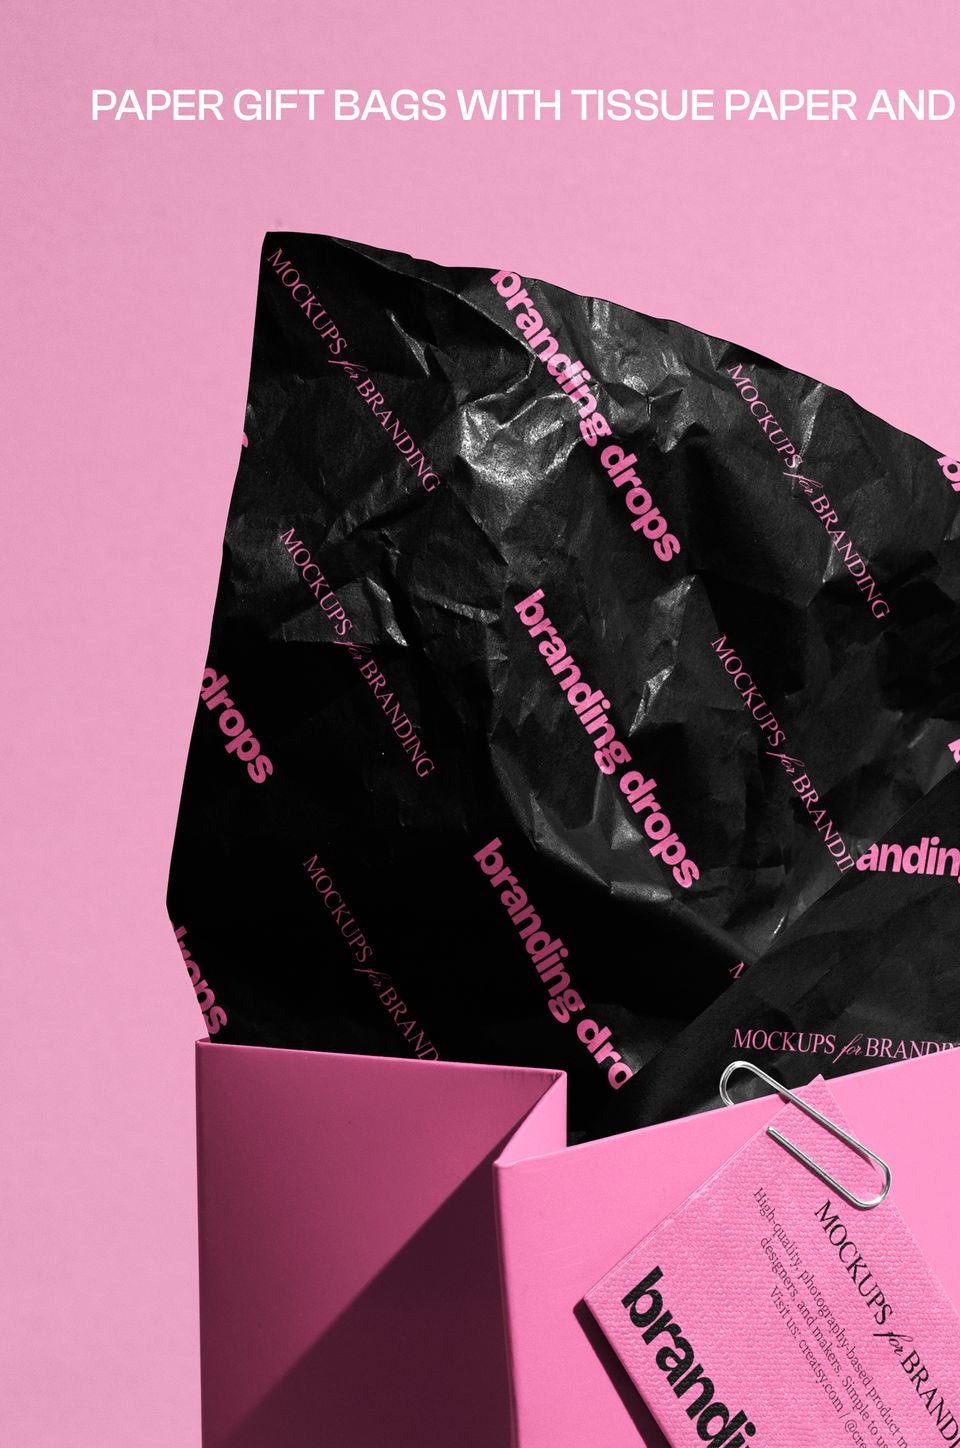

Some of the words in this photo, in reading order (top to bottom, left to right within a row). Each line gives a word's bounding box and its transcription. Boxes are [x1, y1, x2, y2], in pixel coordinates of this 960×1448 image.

[266, 248, 348, 356] MOCKUPS
[328, 359, 361, 382] for
[356, 377, 441, 493] BRANDING
[490, 270, 612, 447] branding
[600, 445, 681, 562] drops
[726, 363, 803, 469] MOCKUPS
[784, 471, 823, 495] for
[810, 494, 890, 619] BRANDING
[200, 667, 273, 785] drops
[279, 528, 353, 636] MOCKUPS
[334, 640, 365, 664] for
[359, 661, 435, 778] BRANDING
[514, 589, 631, 775] branding
[620, 770, 699, 888] drops
[711, 635, 786, 748] MOCKUPS
[766, 750, 806, 776] for
[302, 853, 374, 963] MOCKUPS
[354, 967, 391, 989] for
[473, 838, 586, 1023] branding
[732, 1028, 836, 1054] MOCKUPS
[832, 1033, 864, 1064] for
[753, 1187, 803, 1271] High-quality,
[797, 1270, 873, 1387] photography-based
[866, 1387, 900, 1436] product
[760, 1237, 798, 1301] designers,
[797, 1301, 817, 1327] and
[812, 1326, 842, 1377] makers.
[842, 1375, 870, 1421] Simple
[868, 1421, 878, 1435] to
[771, 1286, 790, 1318] Visit
[786, 1318, 801, 1340] us:
[799, 1339, 844, 1413] creatsy.com
[814, 1199, 893, 1325] MOCKUPS
[873, 1332, 913, 1356] for
